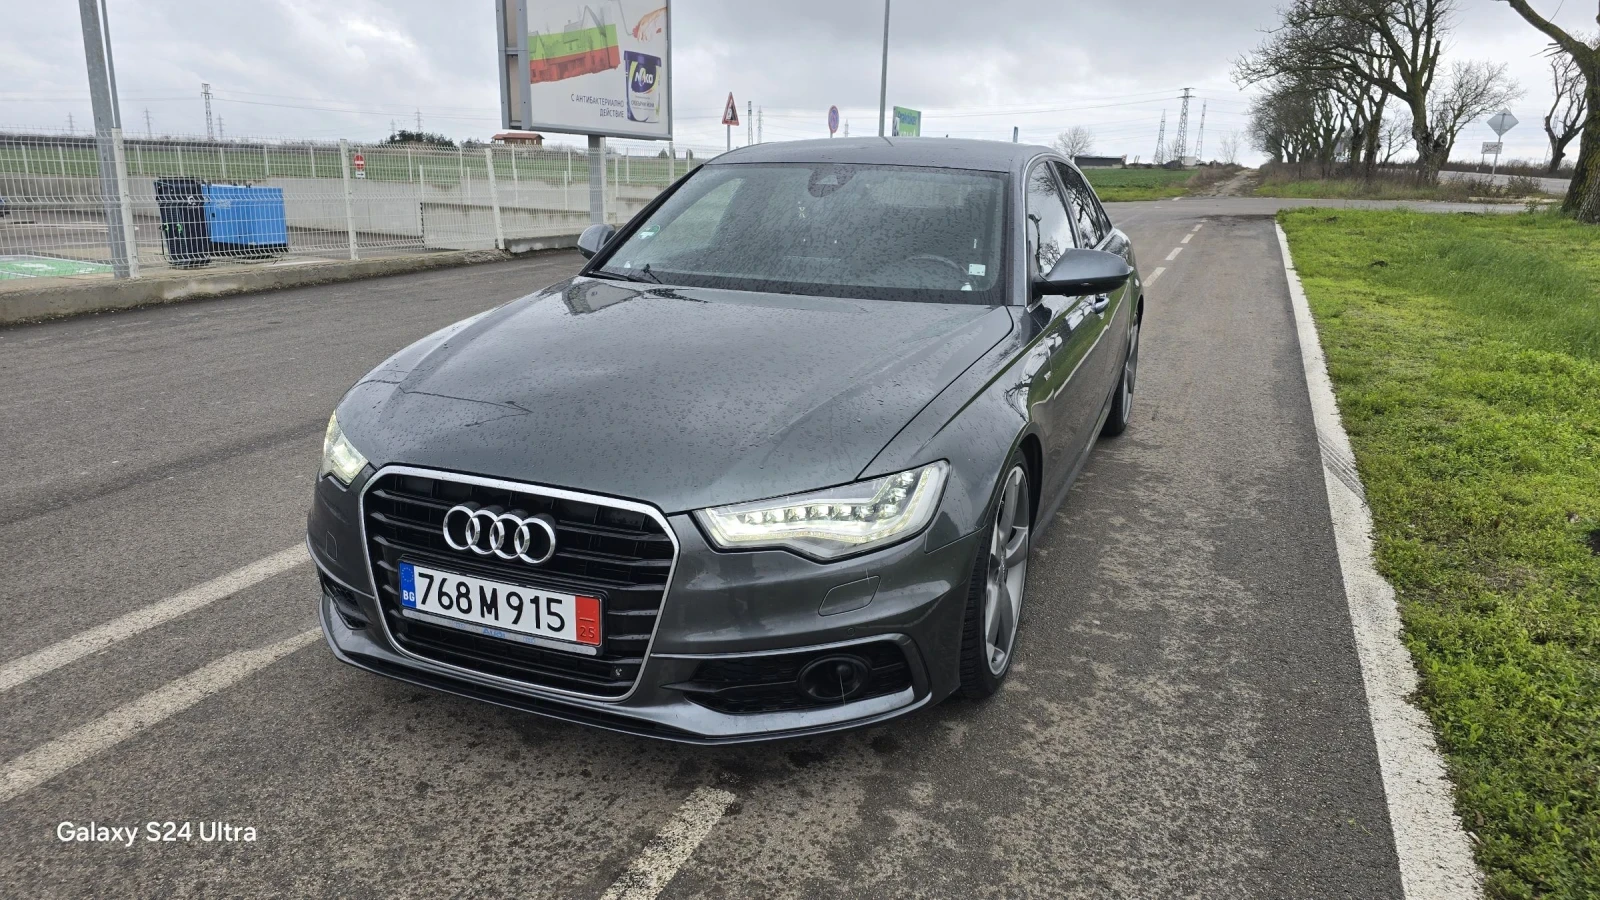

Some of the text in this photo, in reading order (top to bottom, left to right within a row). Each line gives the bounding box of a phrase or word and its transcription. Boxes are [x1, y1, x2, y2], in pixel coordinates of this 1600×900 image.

[599, 108, 624, 118] ДЕЙСТВИЕ
[403, 590, 415, 602] BG
[579, 625, 595, 639] 25
